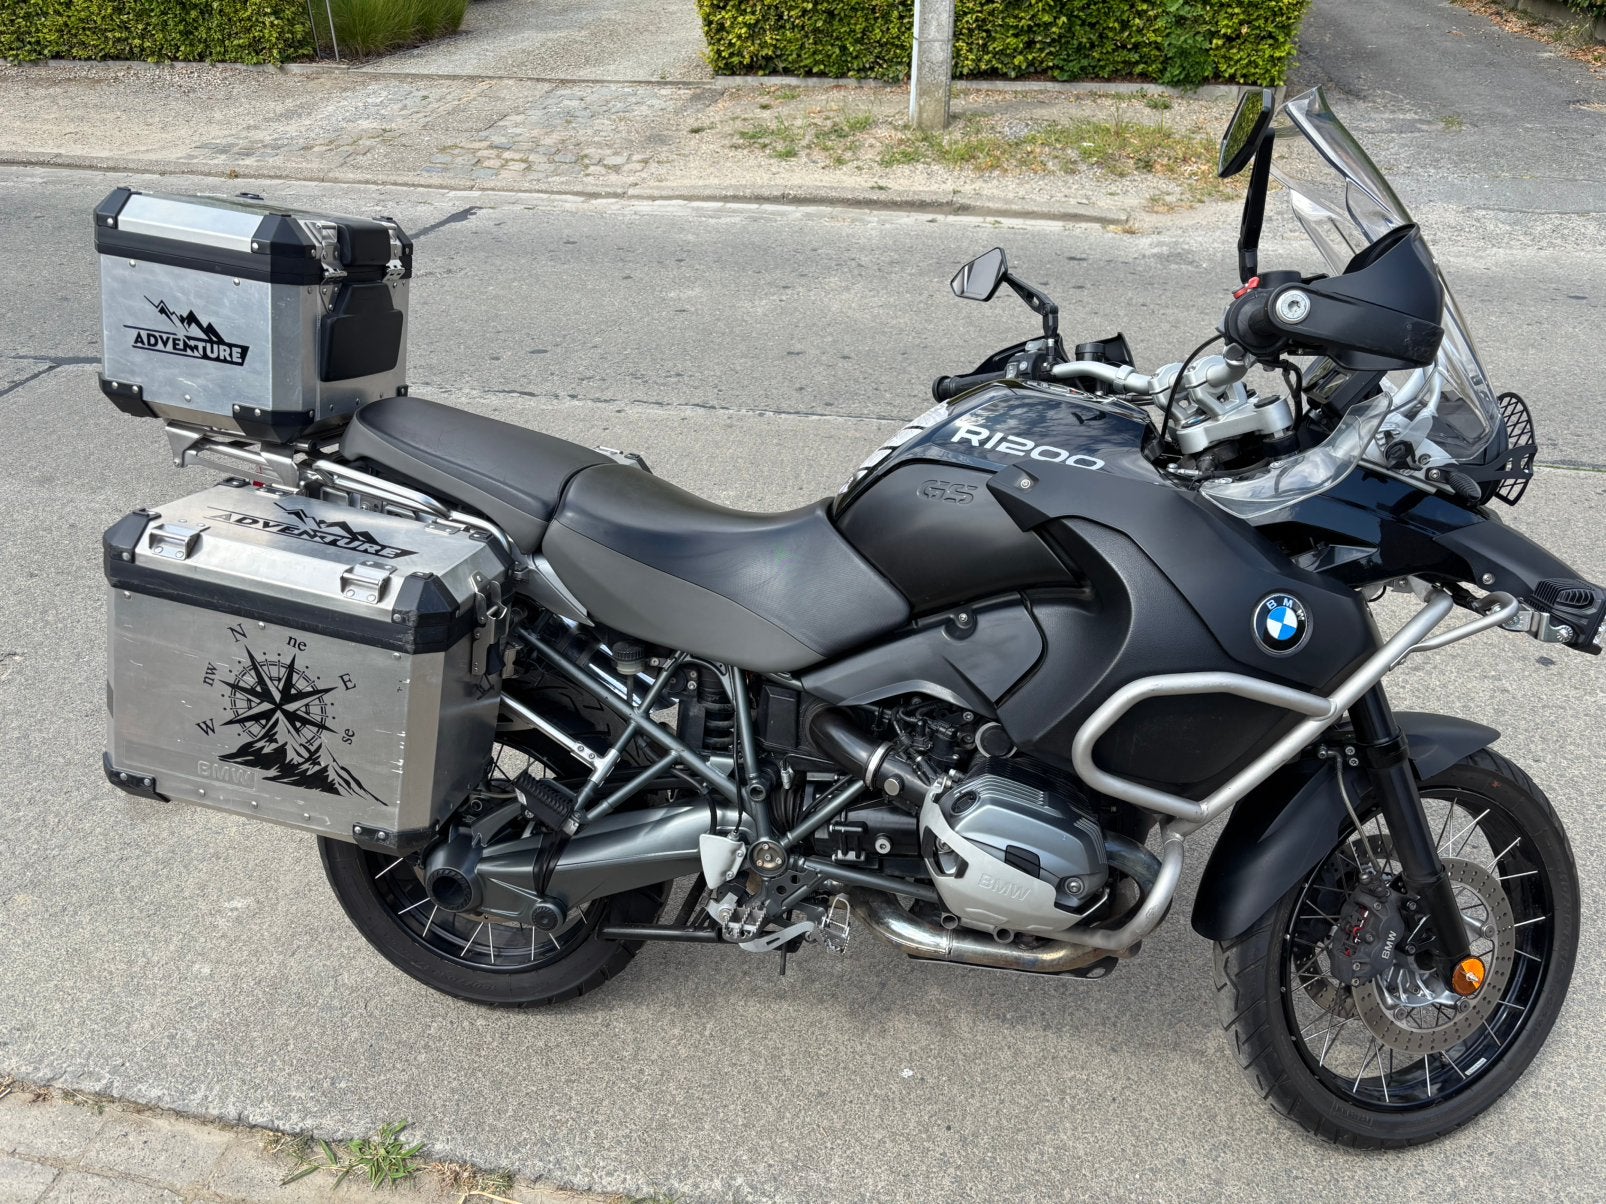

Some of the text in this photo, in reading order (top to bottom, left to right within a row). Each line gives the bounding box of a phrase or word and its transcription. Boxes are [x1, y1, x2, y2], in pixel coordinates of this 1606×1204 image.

[133, 331, 243, 363] ADVENTURE
[950, 424, 1105, 470] R1200
[916, 479, 978, 505] GS
[209, 513, 402, 557] ADVENTURE
[1266, 598, 1305, 621] BMW
[226, 623, 248, 643] N
[286, 635, 307, 652] ne
[203, 662, 218, 687] nw
[338, 673, 357, 691] E
[195, 718, 216, 737] W
[341, 728, 355, 745] se
[197, 760, 254, 786] BMW
[977, 872, 1033, 901] BMW
[1381, 930, 1398, 960] BMW
